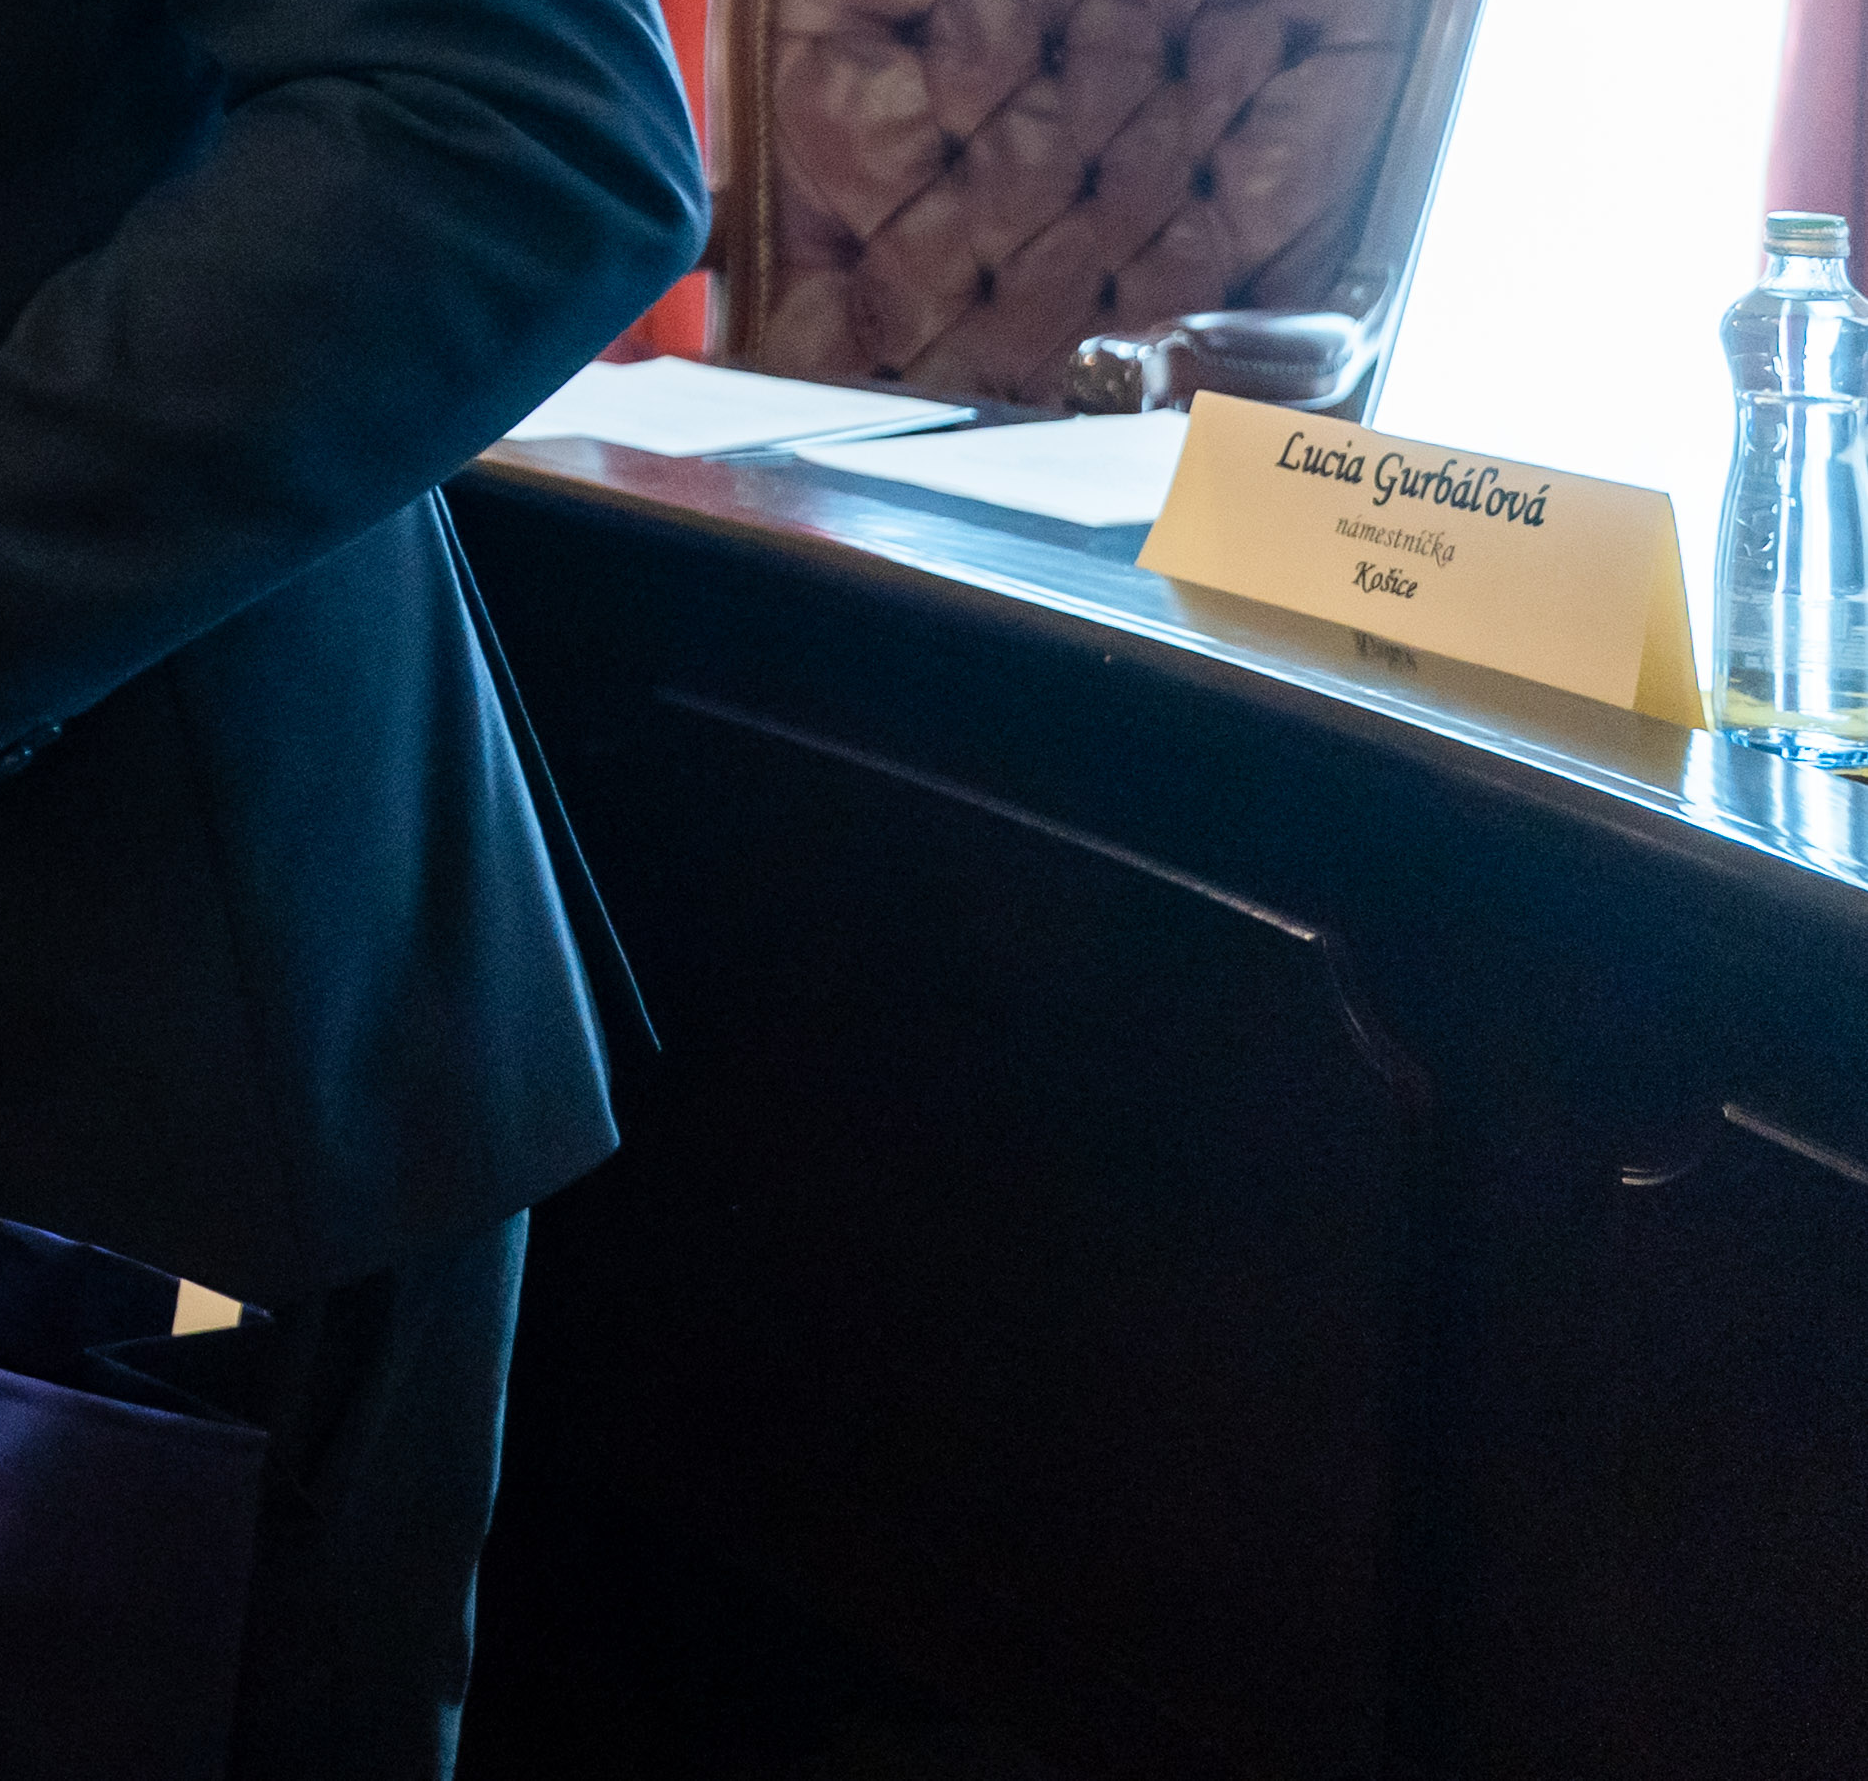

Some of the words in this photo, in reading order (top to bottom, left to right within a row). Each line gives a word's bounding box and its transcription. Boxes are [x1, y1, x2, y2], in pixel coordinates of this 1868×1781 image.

[1275, 430, 1366, 484] Lucia
[1372, 451, 1551, 527] Gurbáľová
[1335, 513, 1456, 568] námestníčka
[1352, 560, 1419, 599] Košice
